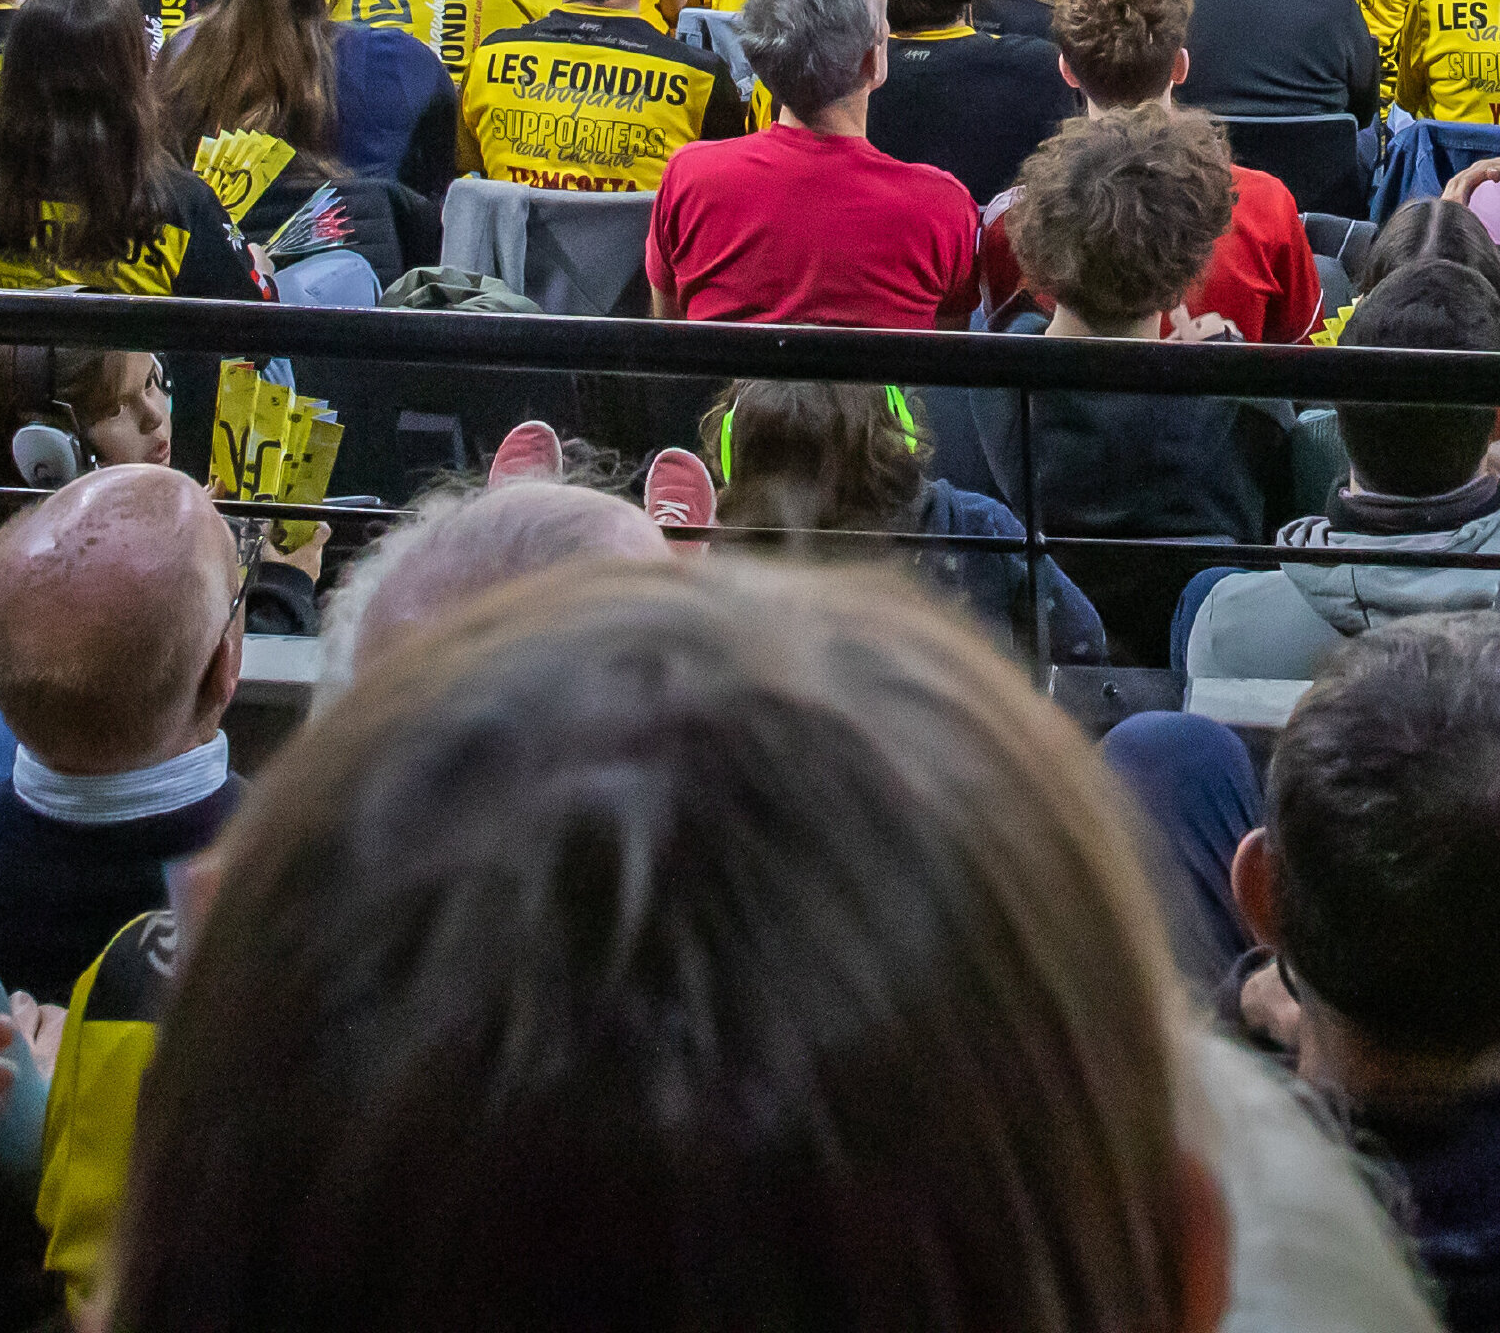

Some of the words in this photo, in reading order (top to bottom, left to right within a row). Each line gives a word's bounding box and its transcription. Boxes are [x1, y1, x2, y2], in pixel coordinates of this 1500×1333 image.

[1437, 2, 1487, 32] LES
[487, 53, 539, 87] LES
[549, 59, 689, 106] FONDUS
[514, 74, 650, 119] Savoyards
[491, 108, 666, 158] SUPPORTERS
